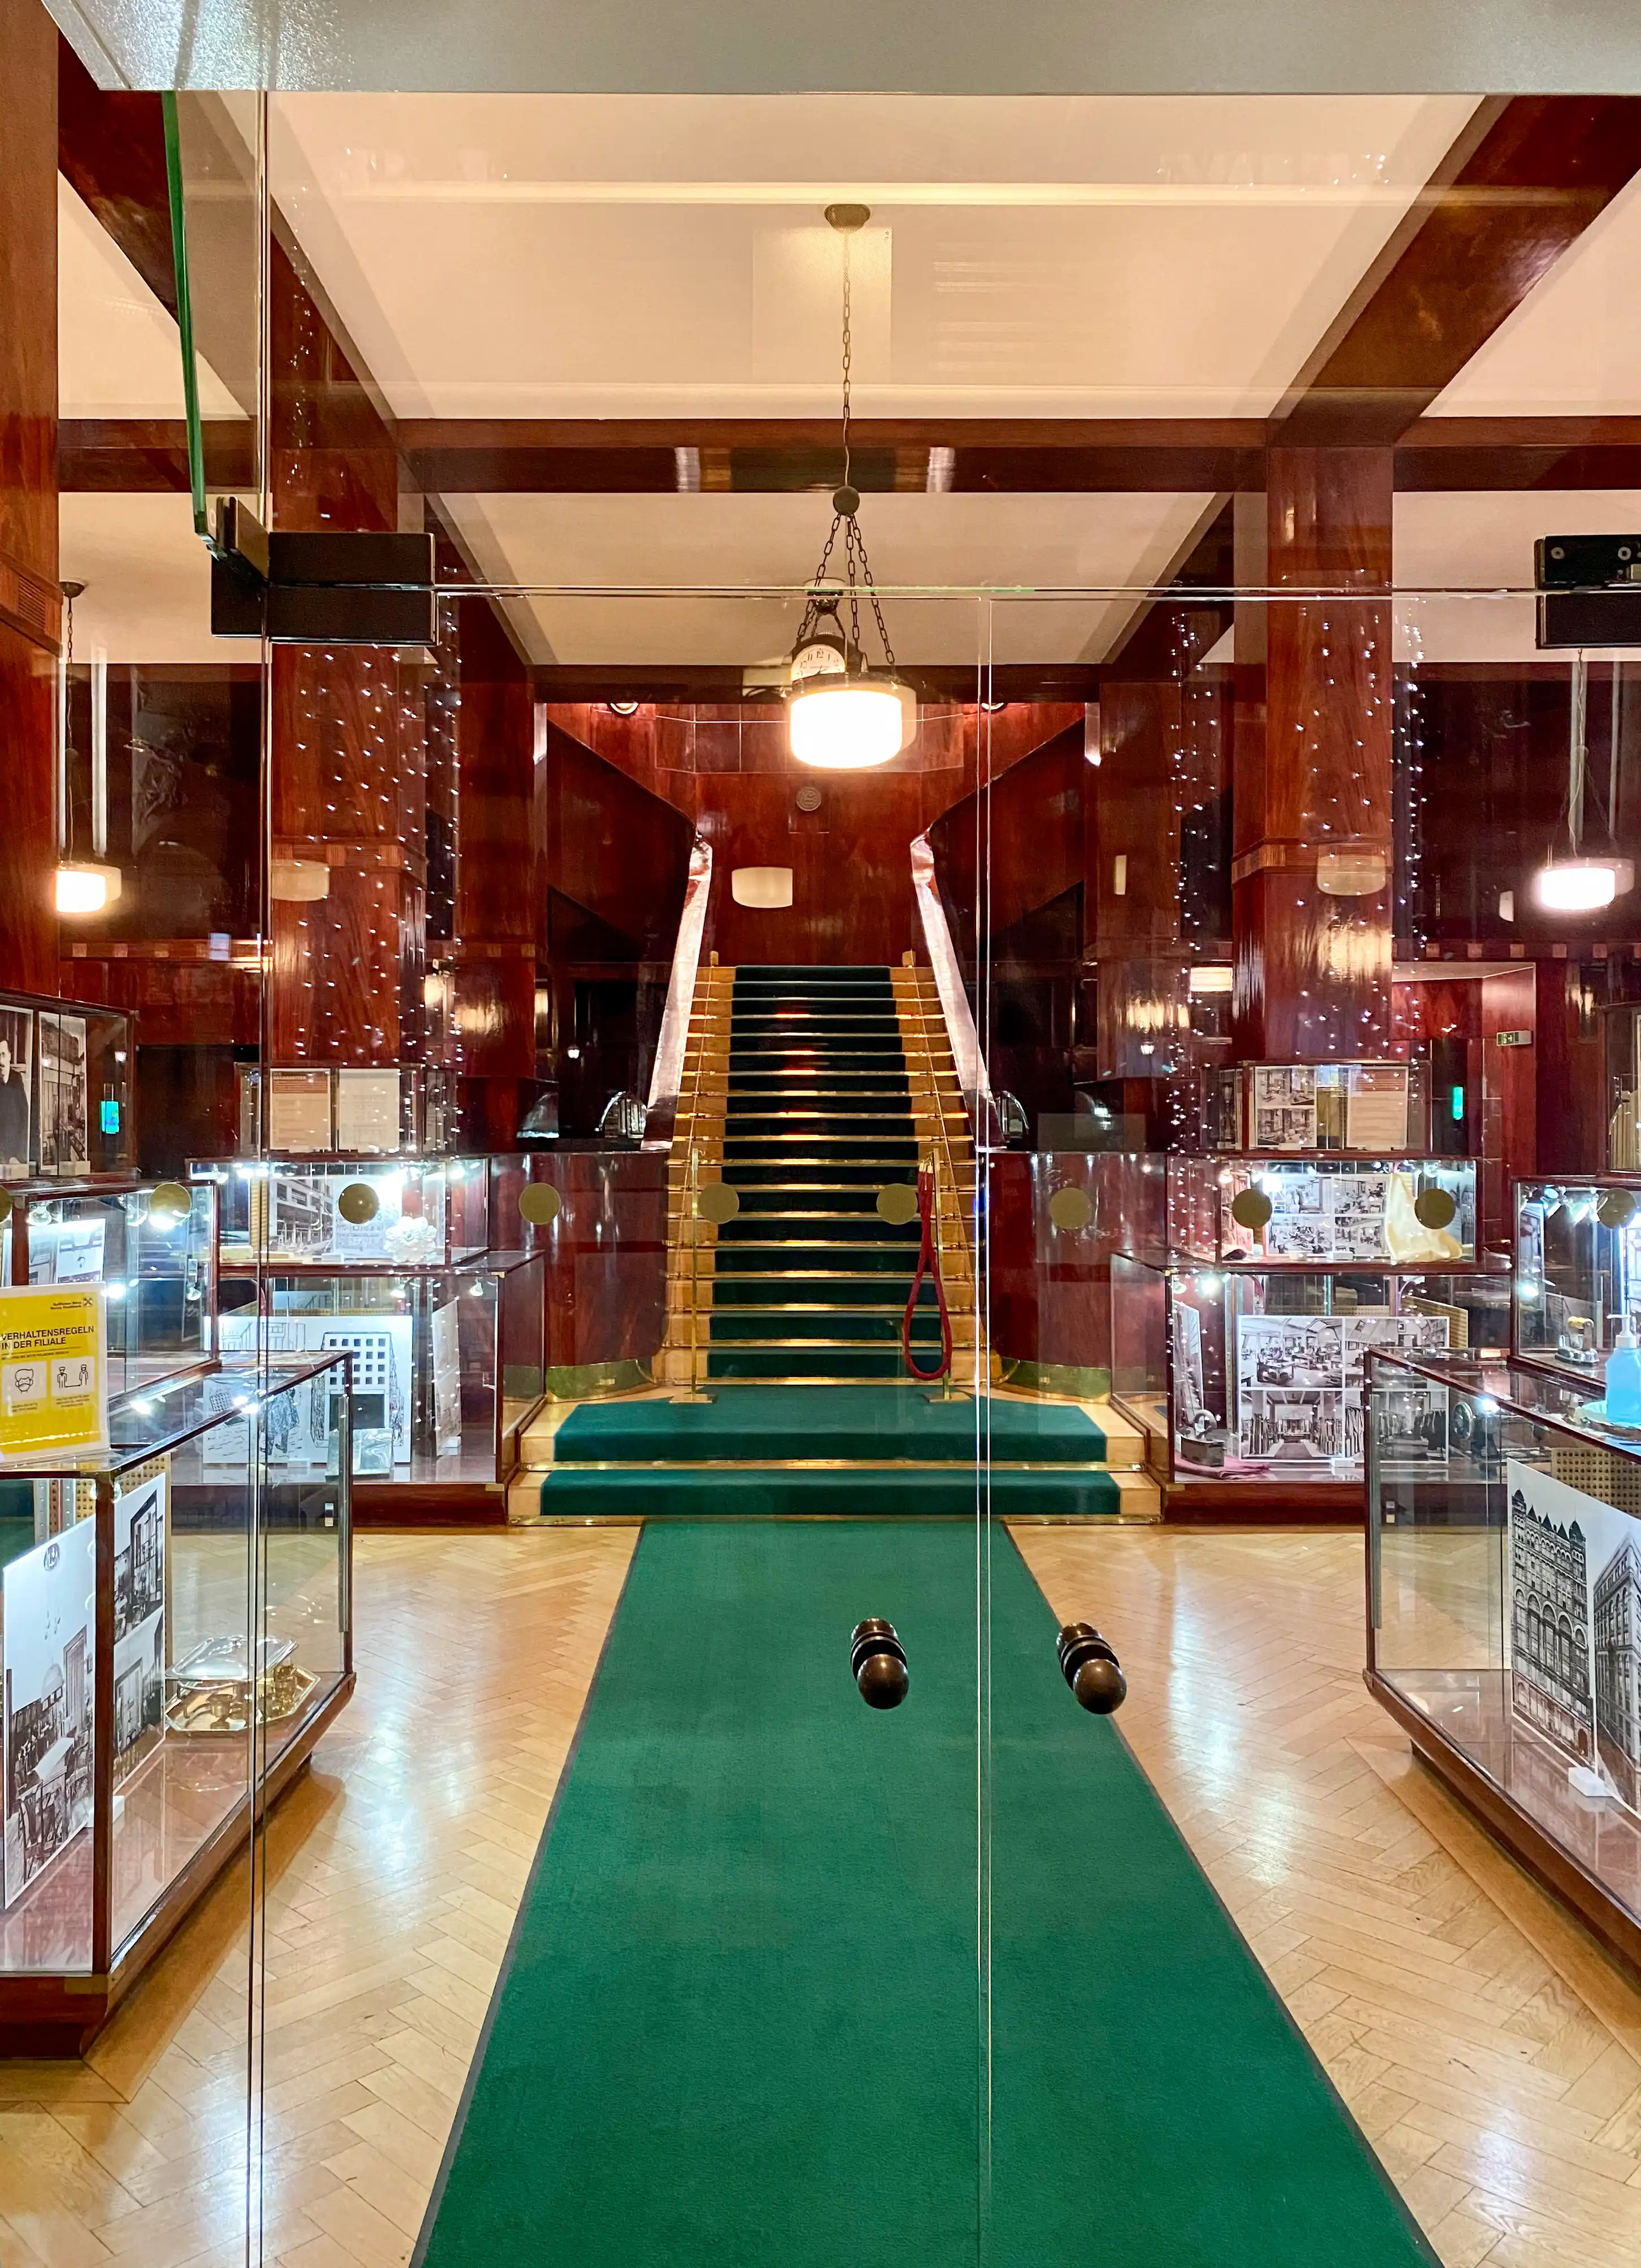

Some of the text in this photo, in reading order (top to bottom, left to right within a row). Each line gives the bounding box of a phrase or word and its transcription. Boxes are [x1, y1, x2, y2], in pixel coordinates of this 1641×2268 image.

[2, 1325, 94, 1341] VERHALTENSREGELN
[2, 1336, 66, 1350] IN DER FILIALE
